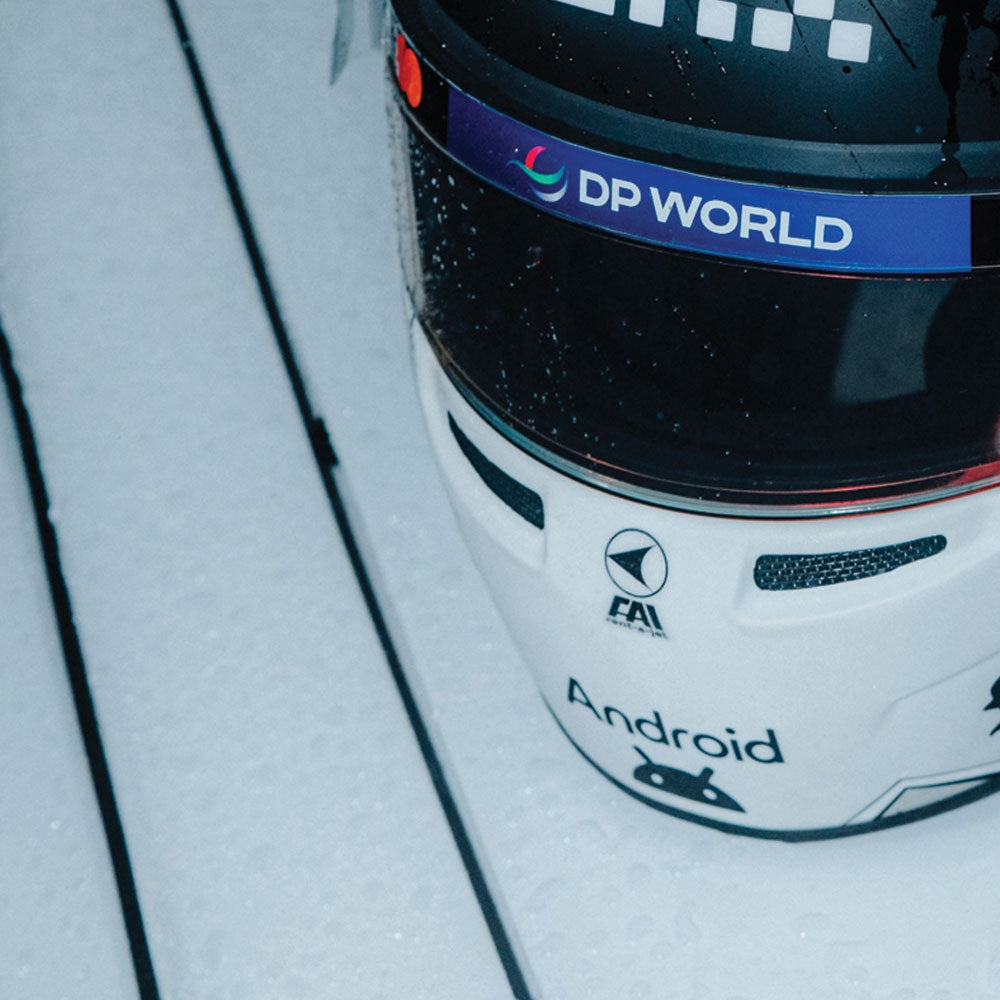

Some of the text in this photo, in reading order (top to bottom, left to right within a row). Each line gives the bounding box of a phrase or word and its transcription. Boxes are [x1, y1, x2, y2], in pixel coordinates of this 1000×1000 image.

[579, 170, 853, 251] DP WORLD
[609, 595, 663, 631] FAI
[567, 677, 785, 764] Android
